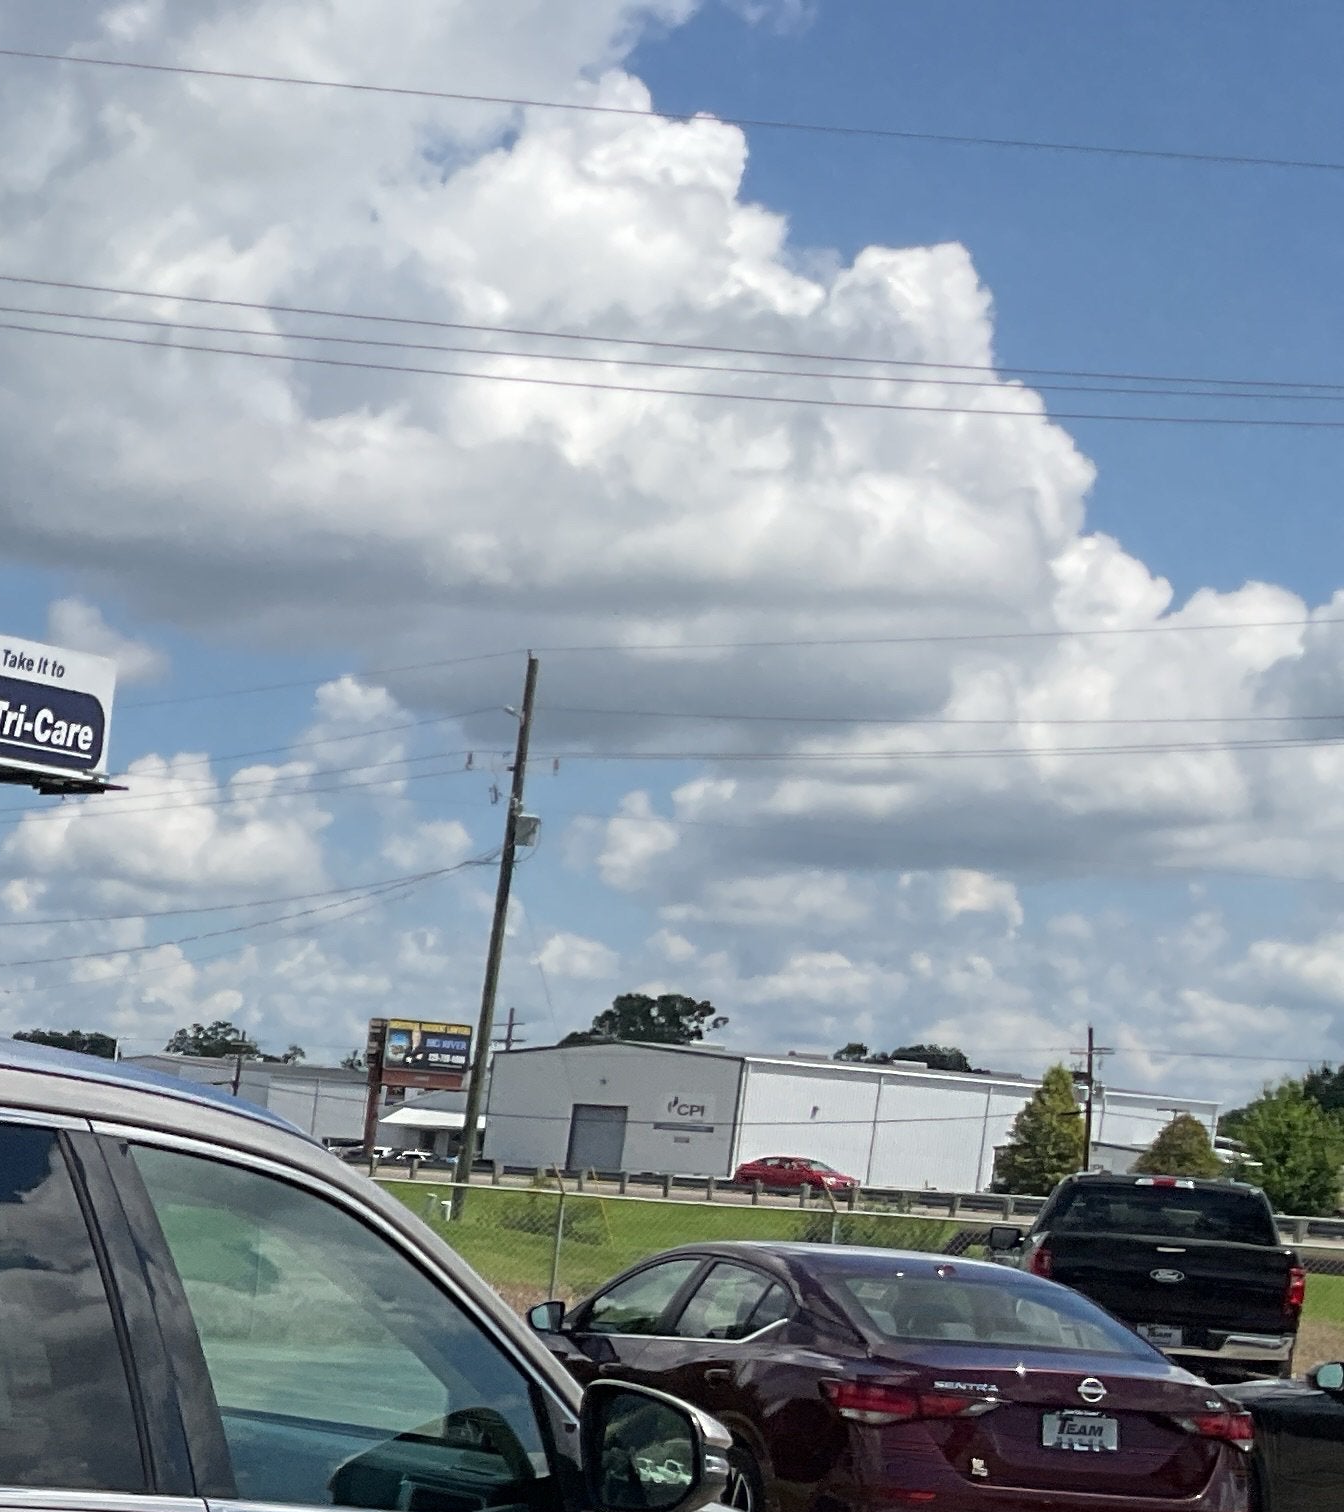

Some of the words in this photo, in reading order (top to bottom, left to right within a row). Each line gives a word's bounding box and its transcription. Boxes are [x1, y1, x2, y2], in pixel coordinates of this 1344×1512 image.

[2, 648, 35, 672] Take
[37, 656, 49, 675] It
[51, 660, 66, 679] to
[677, 1103, 705, 1117] CPI
[933, 1380, 999, 1392] SENTRA
[1056, 1414, 1104, 1437] TEAM
